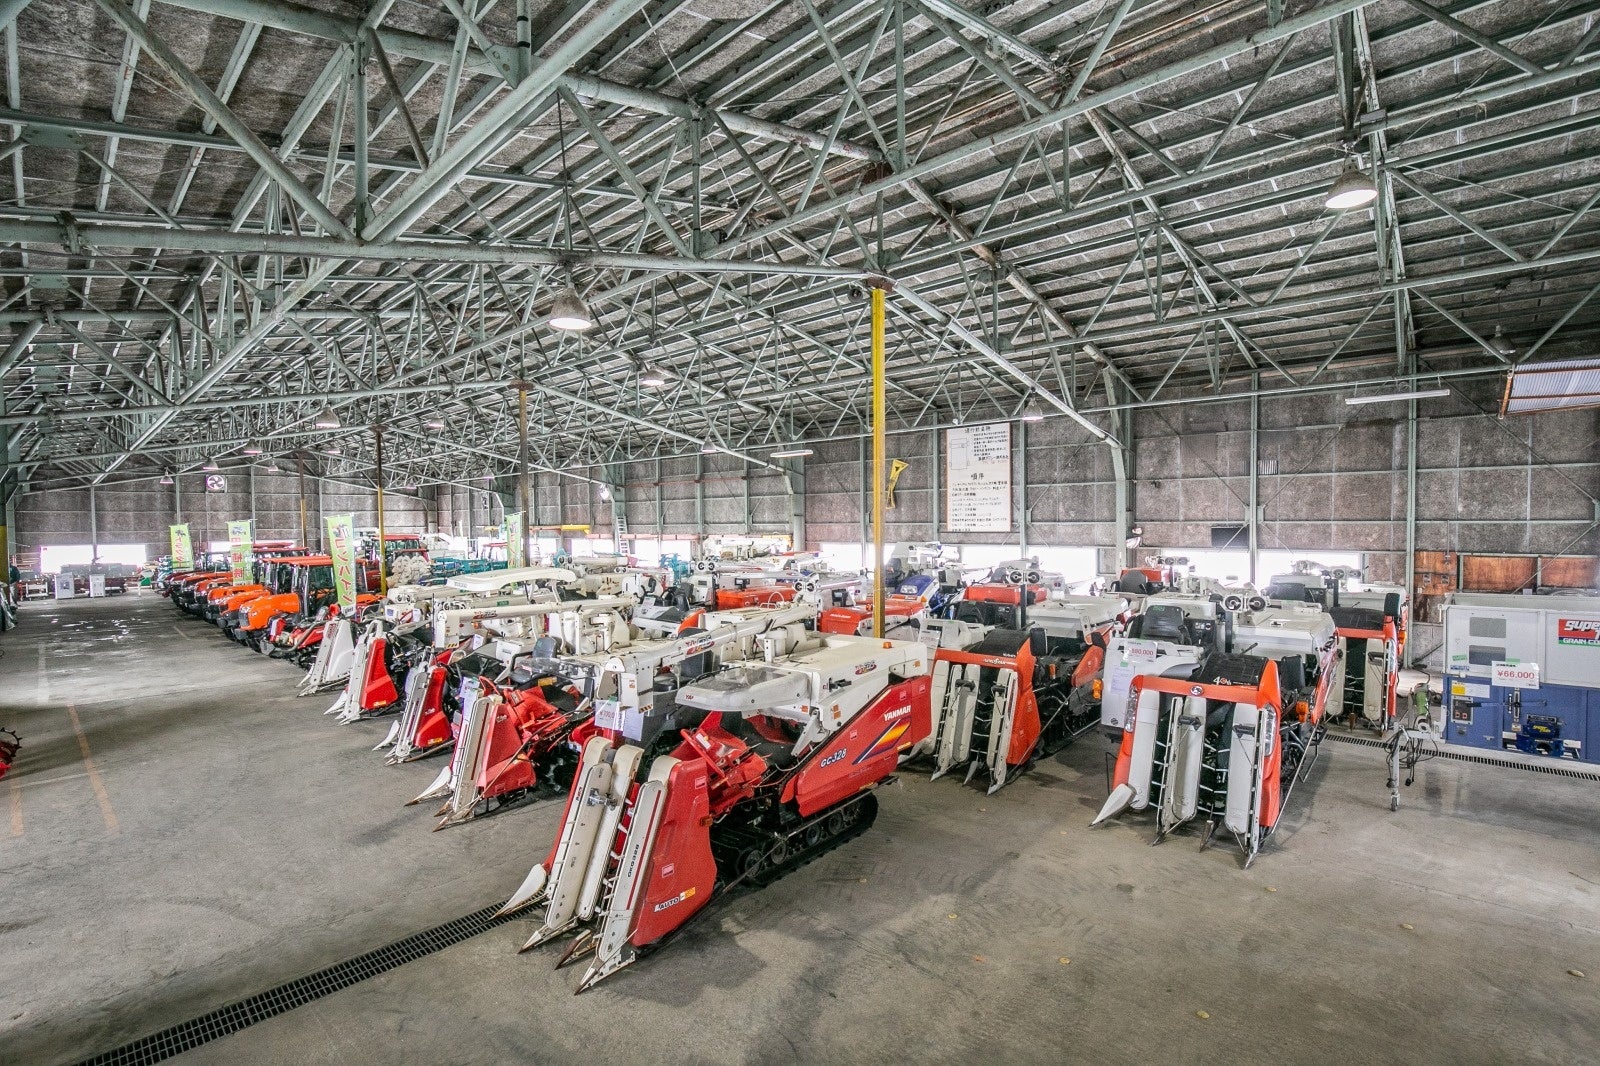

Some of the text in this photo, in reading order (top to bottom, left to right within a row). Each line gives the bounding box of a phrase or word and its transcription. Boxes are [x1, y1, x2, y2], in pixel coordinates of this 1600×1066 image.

[1563, 637, 1587, 645] GRAIN
[883, 705, 911, 721] YANMAR
[820, 747, 848, 768] GC328
[657, 896, 680, 910] AUTO
